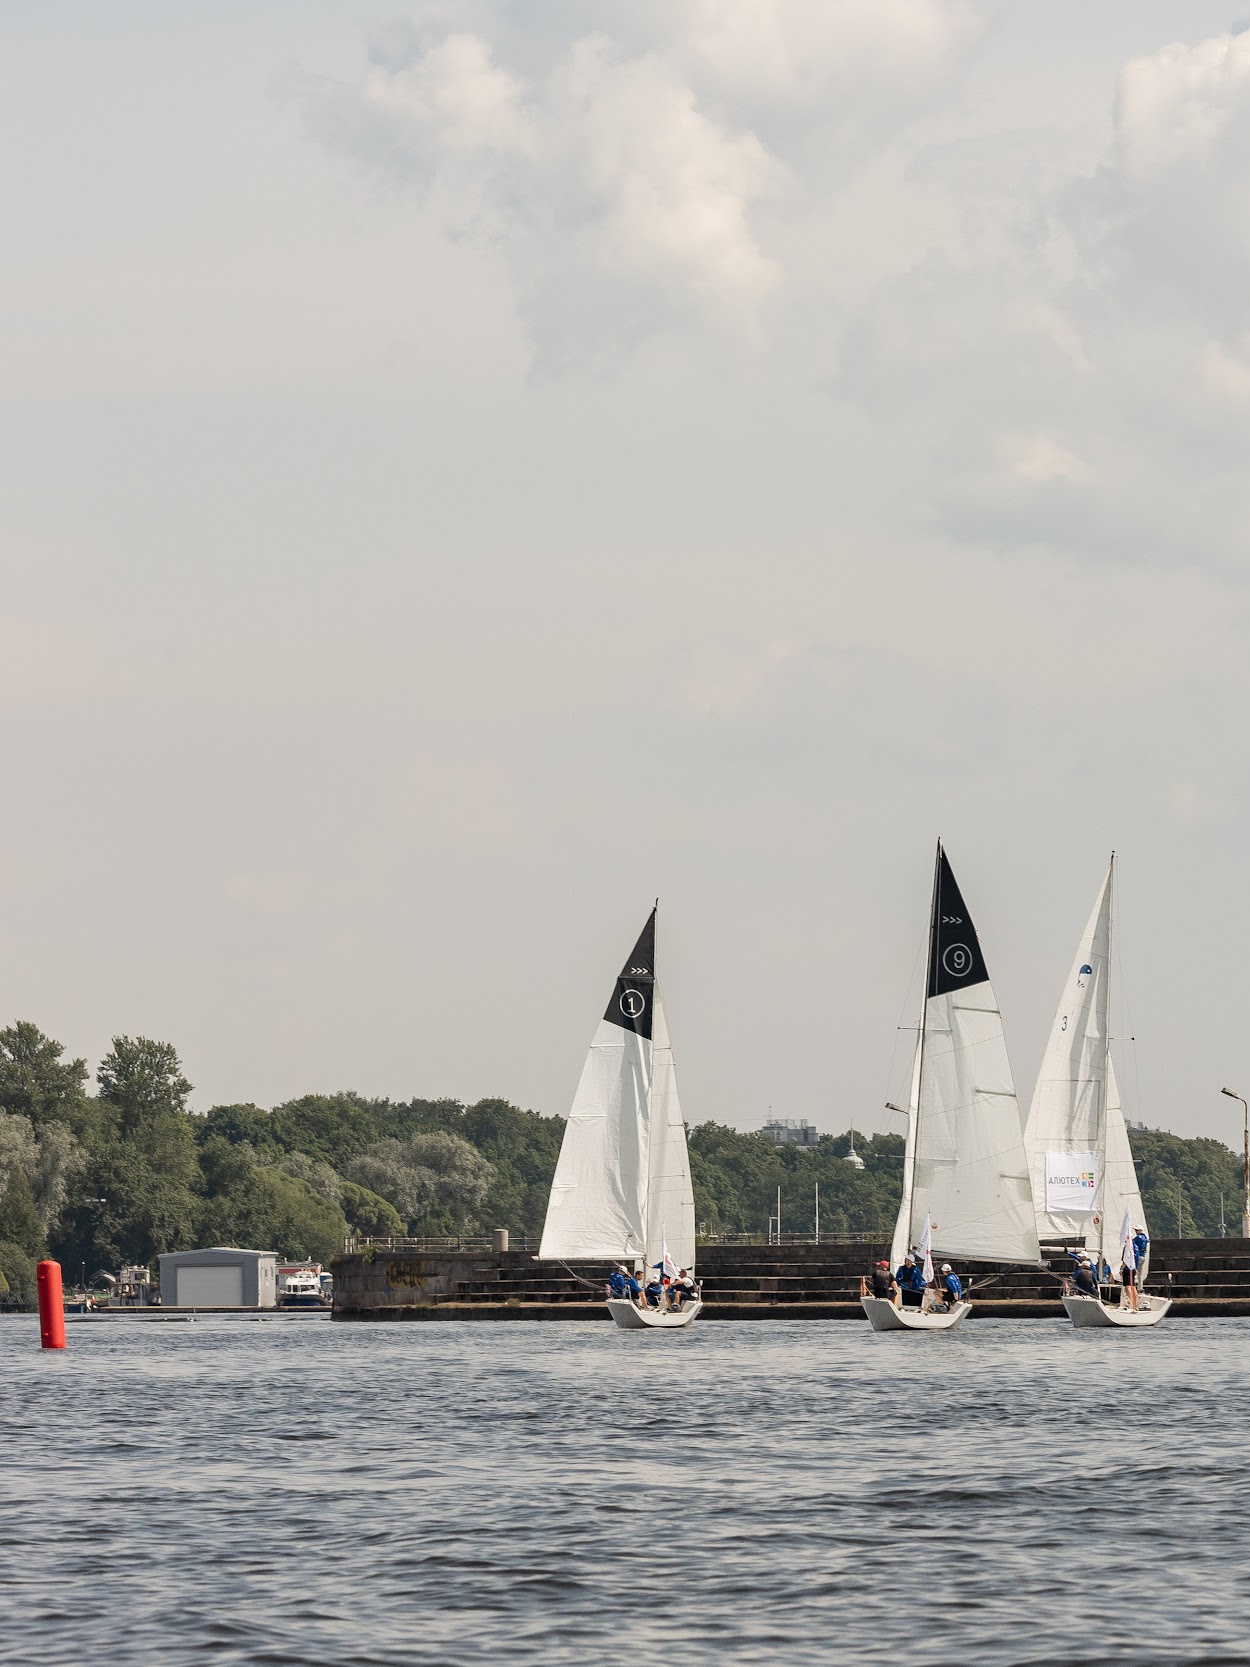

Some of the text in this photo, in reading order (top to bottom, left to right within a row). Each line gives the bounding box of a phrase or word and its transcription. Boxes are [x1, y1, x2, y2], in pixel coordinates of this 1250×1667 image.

[953, 950, 965, 968] 9
[627, 997, 636, 1013] 1
[1061, 1015, 1068, 1031] 3
[1048, 1176, 1081, 1185] АЛЮТЕХ
